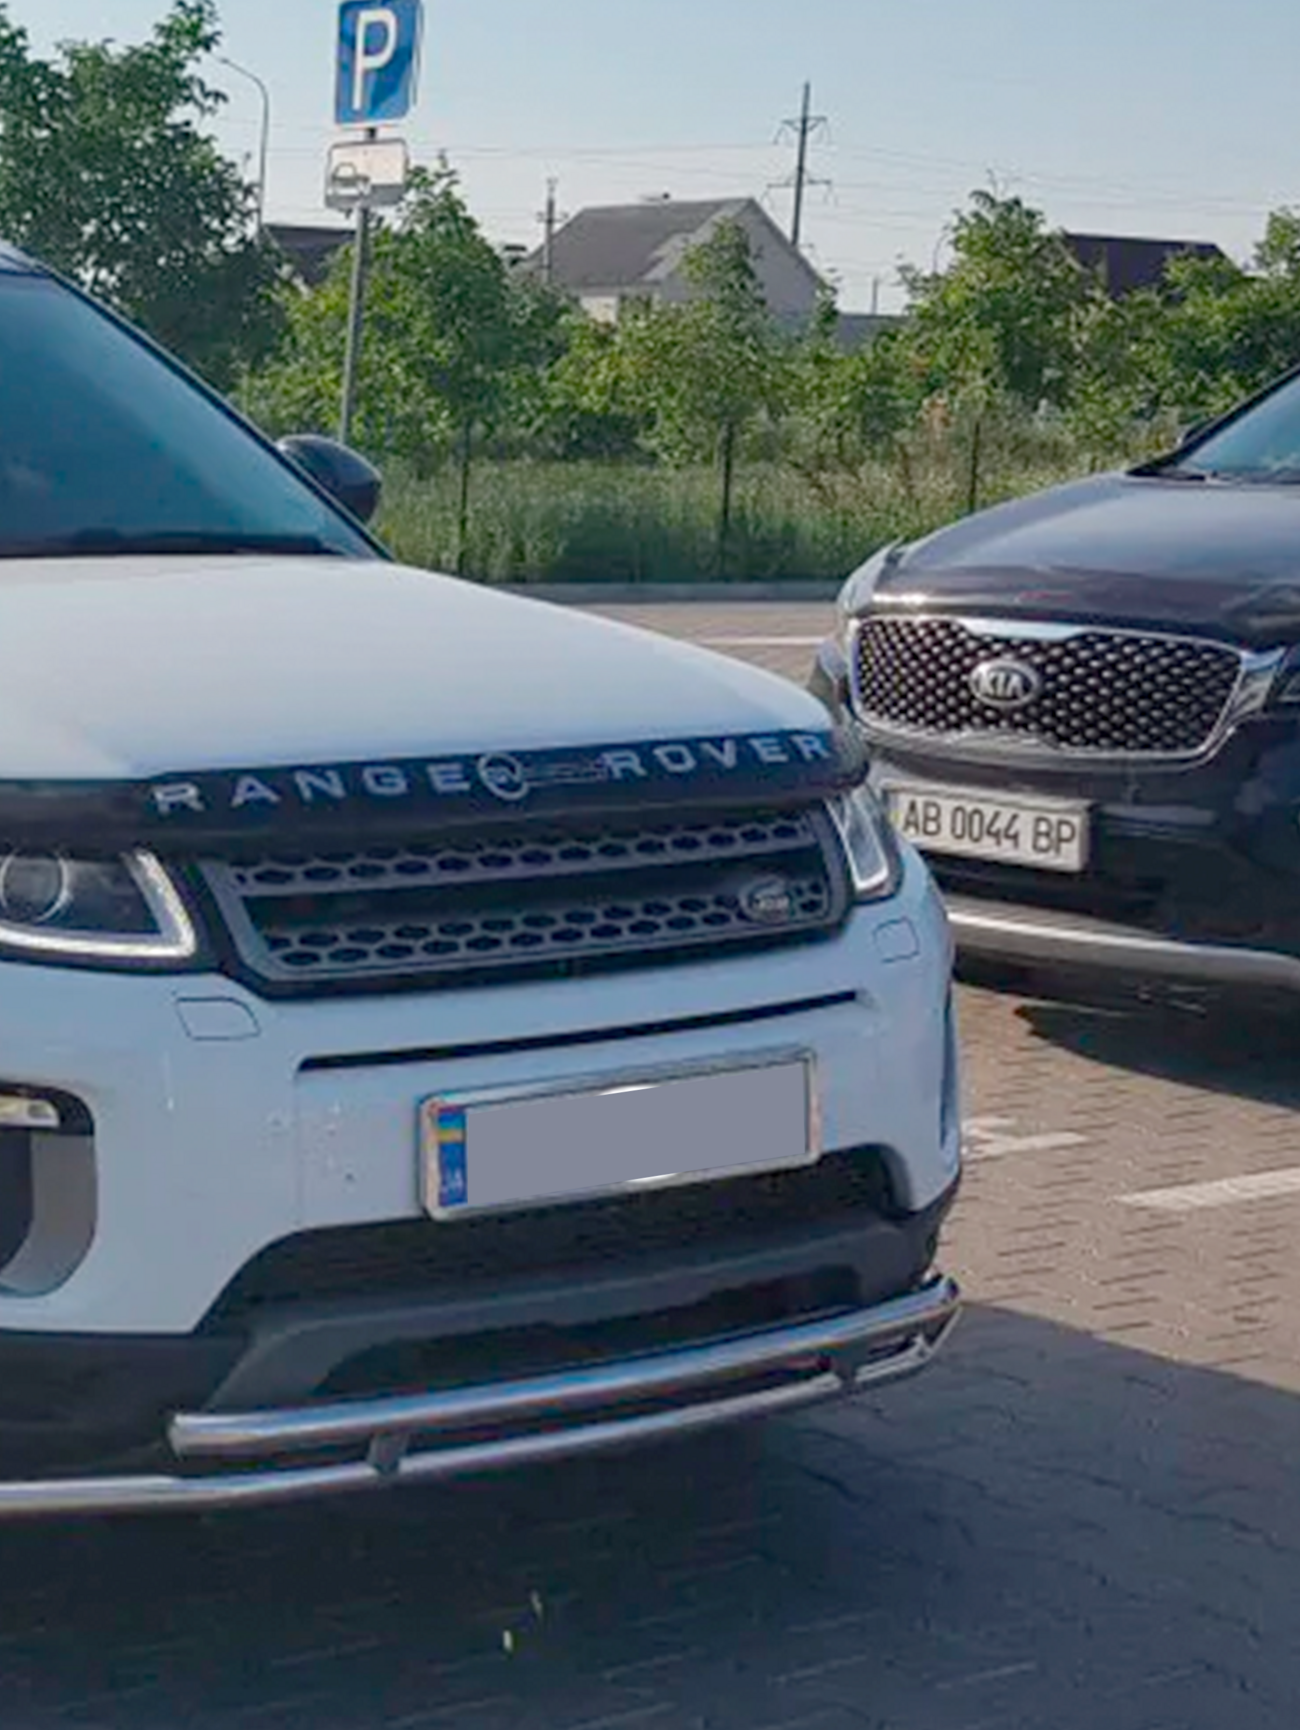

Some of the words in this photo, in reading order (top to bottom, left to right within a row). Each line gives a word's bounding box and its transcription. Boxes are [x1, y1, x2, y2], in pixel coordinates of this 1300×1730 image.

[353, 8, 397, 111] P
[980, 668, 1024, 700] KIA
[152, 762, 472, 815] RANGE
[602, 734, 832, 780] ROVER
[902, 799, 942, 837] AB
[951, 805, 1019, 850] 0044
[1032, 815, 1077, 857] BP
